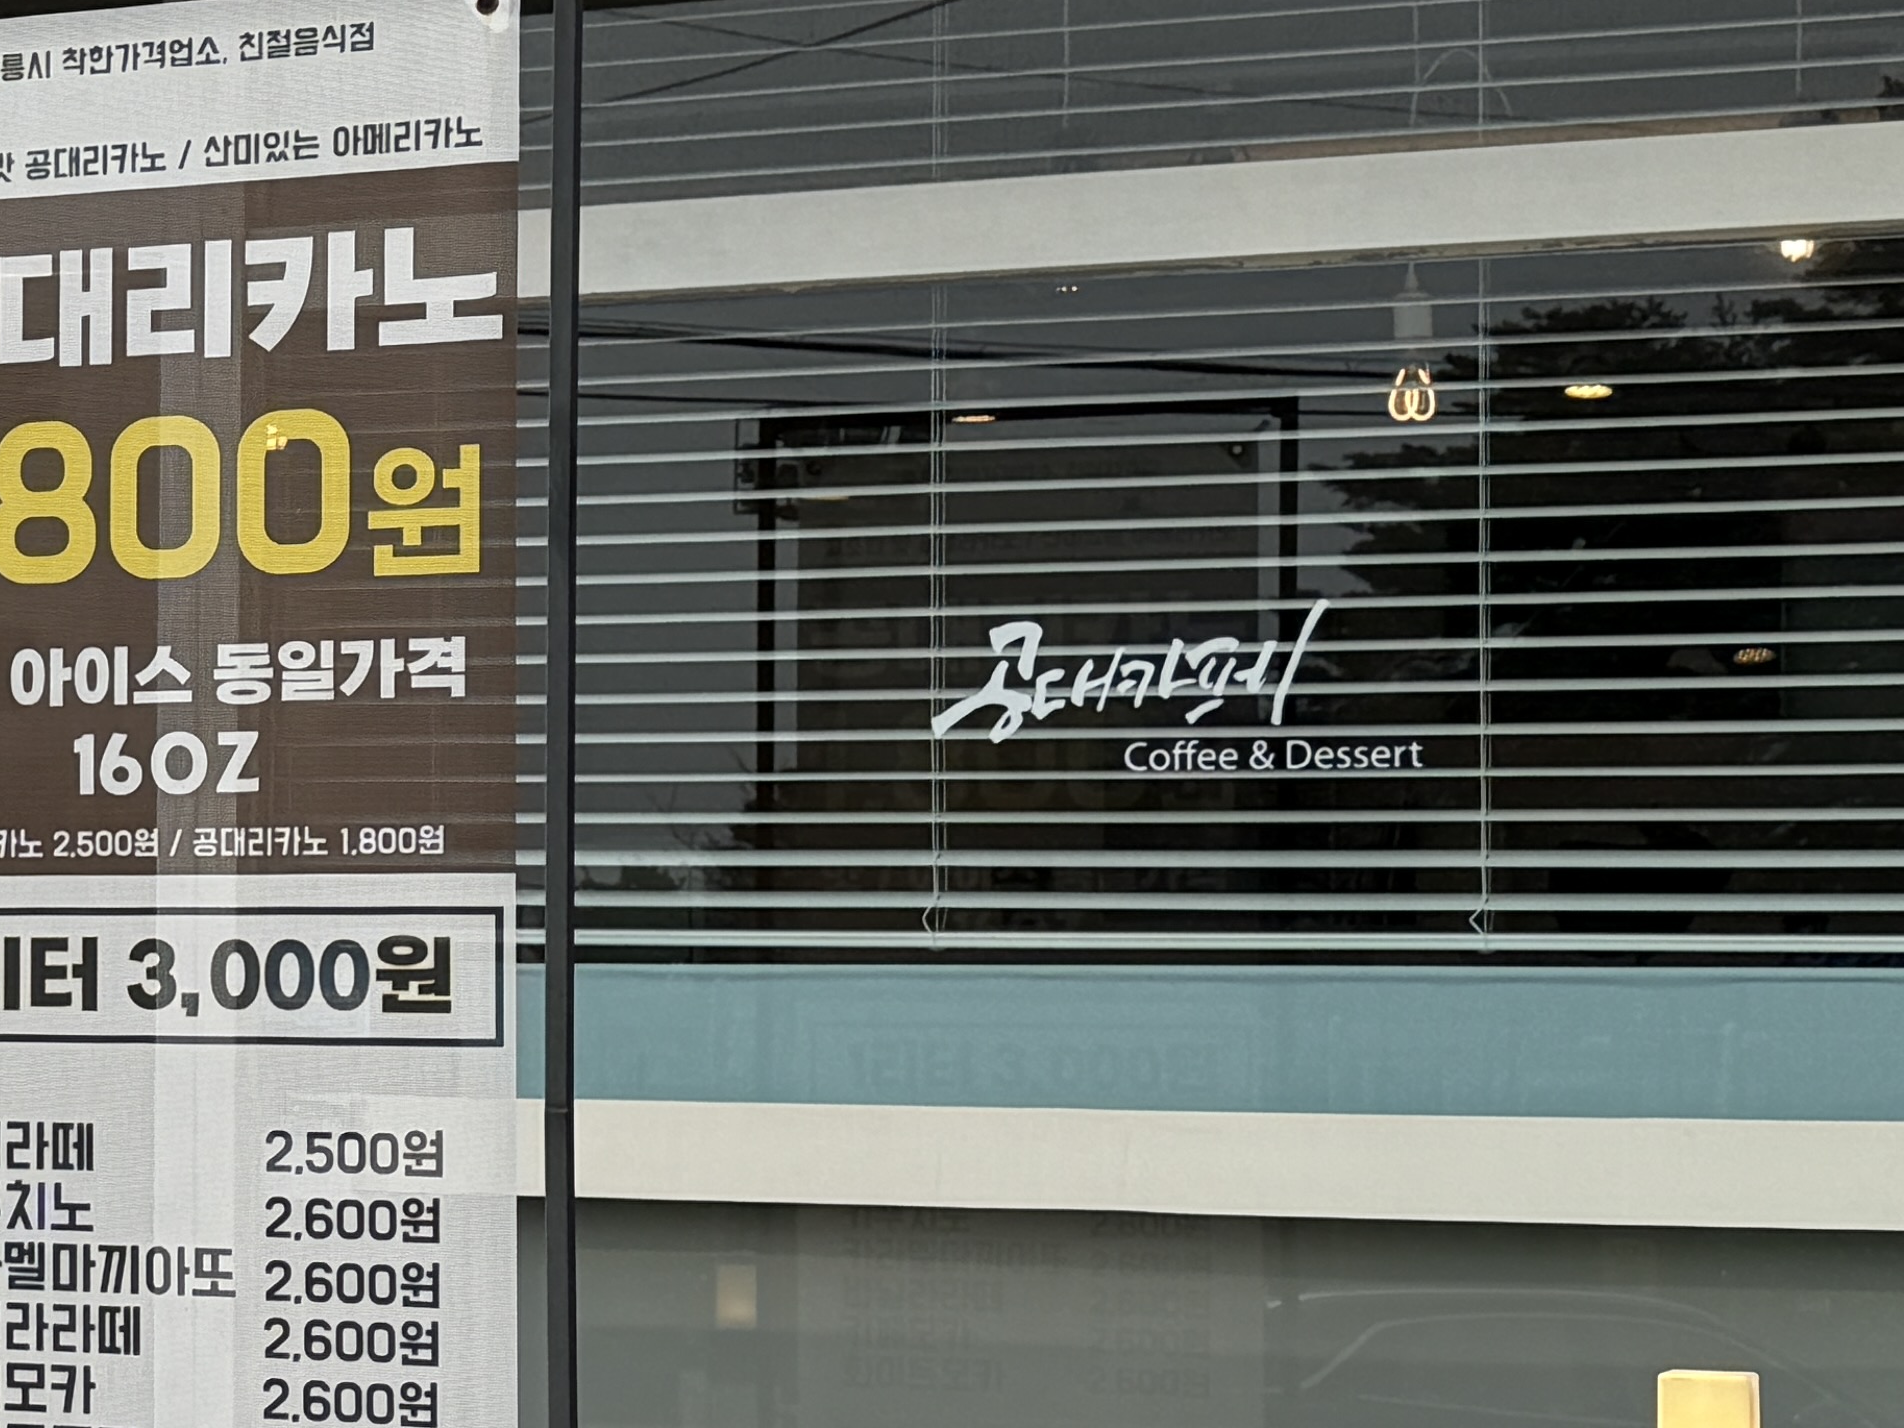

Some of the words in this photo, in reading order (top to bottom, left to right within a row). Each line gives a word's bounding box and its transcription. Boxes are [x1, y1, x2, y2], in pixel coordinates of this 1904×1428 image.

[62, 36, 228, 76] 착한가격업소,
[239, 21, 375, 62] 친절음식점
[24, 141, 167, 181] 공대리카노
[178, 139, 192, 170] /
[203, 129, 320, 168] 산미있는
[332, 116, 483, 157] 아메리카노
[10, 645, 193, 707] 아이스
[212, 636, 466, 705] 동일가격
[931, 597, 1329, 744] 공대카페
[73, 730, 260, 796] 16OZ
[1123, 740, 1239, 772] Coffee
[1248, 739, 1275, 771] &
[1285, 739, 1425, 771] Dessert
[169, 828, 183, 857] /
[192, 826, 329, 858] 공대리카노
[126, 934, 452, 1017] 3,000원
